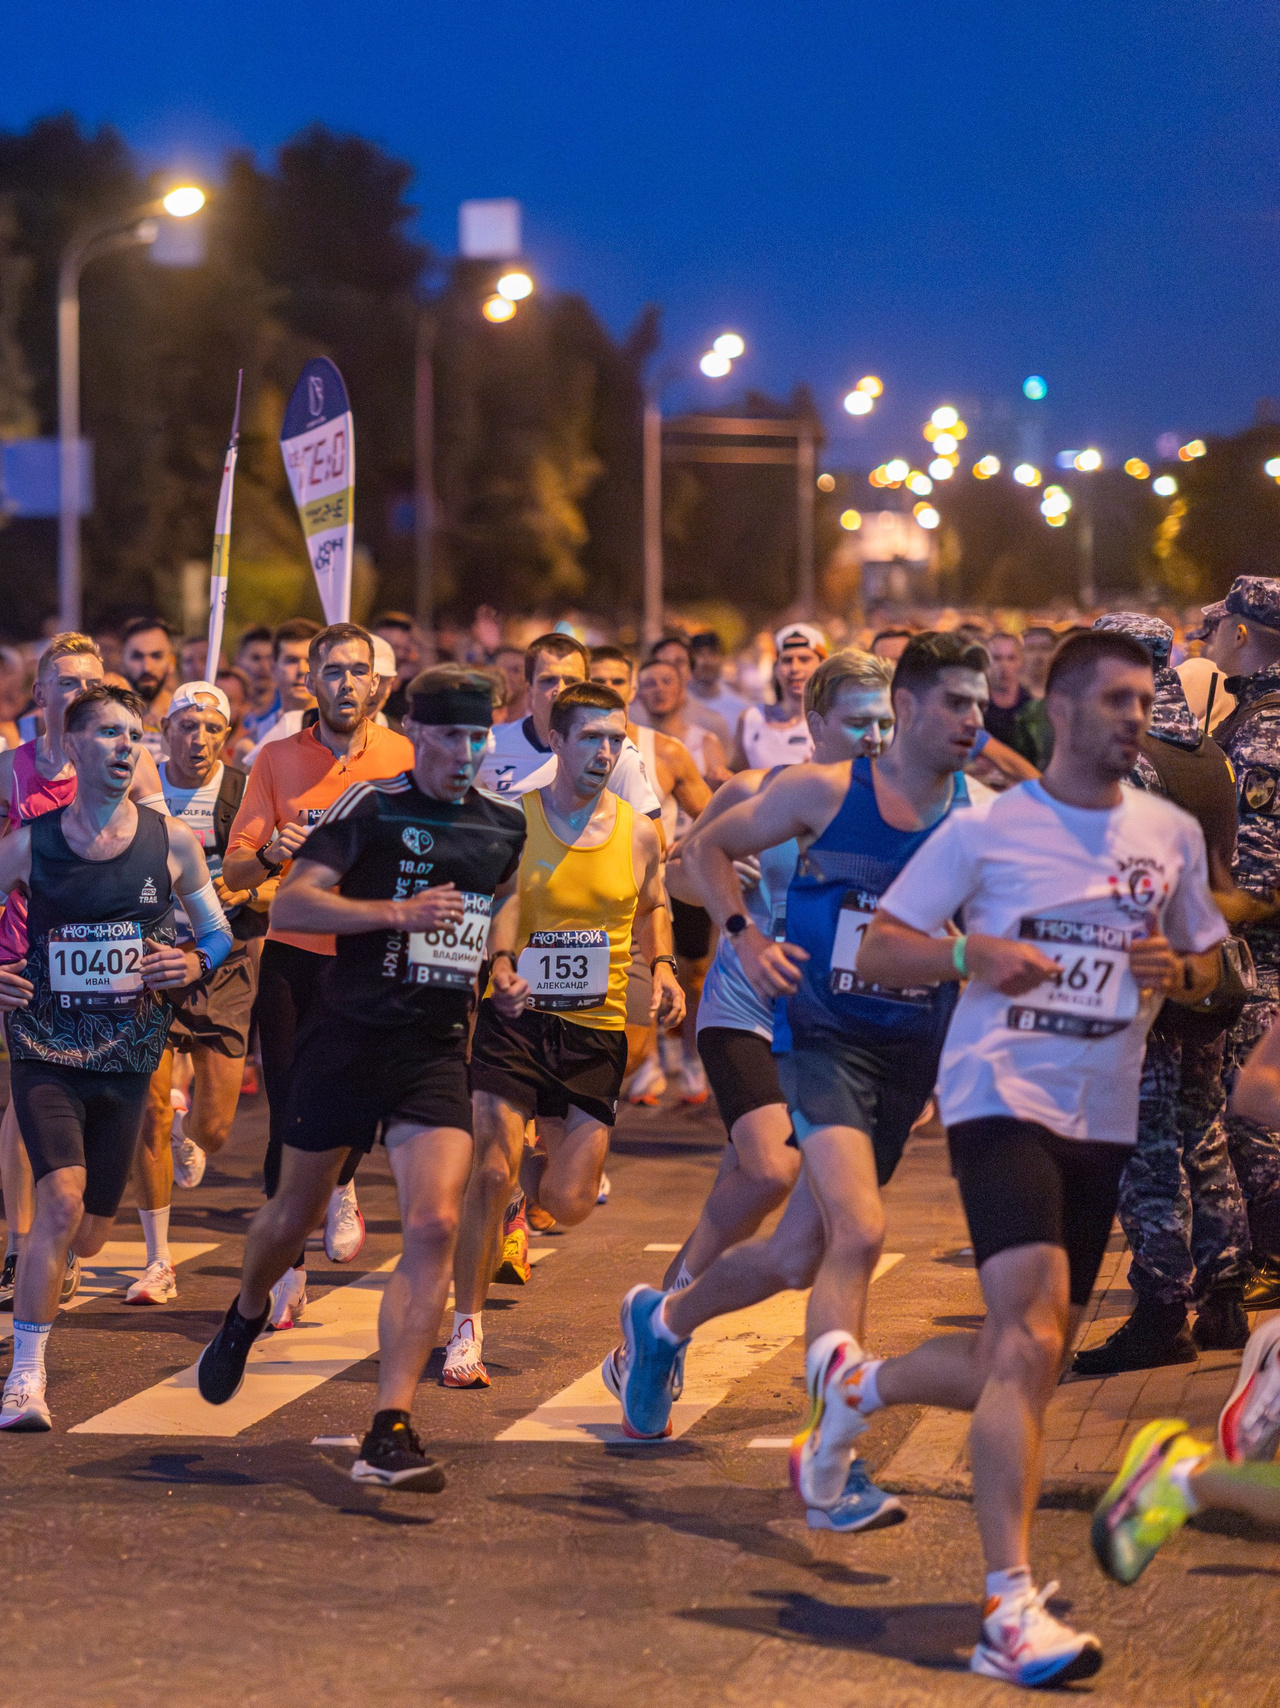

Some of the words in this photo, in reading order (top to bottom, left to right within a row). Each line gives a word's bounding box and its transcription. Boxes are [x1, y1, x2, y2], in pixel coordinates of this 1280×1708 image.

[399, 859, 434, 875] 18.07
[55, 947, 140, 976] 10402
[539, 955, 588, 980] 153
[85, 977, 110, 986] ИВАН
[536, 981, 589, 990] АЛЕКСАНДР
